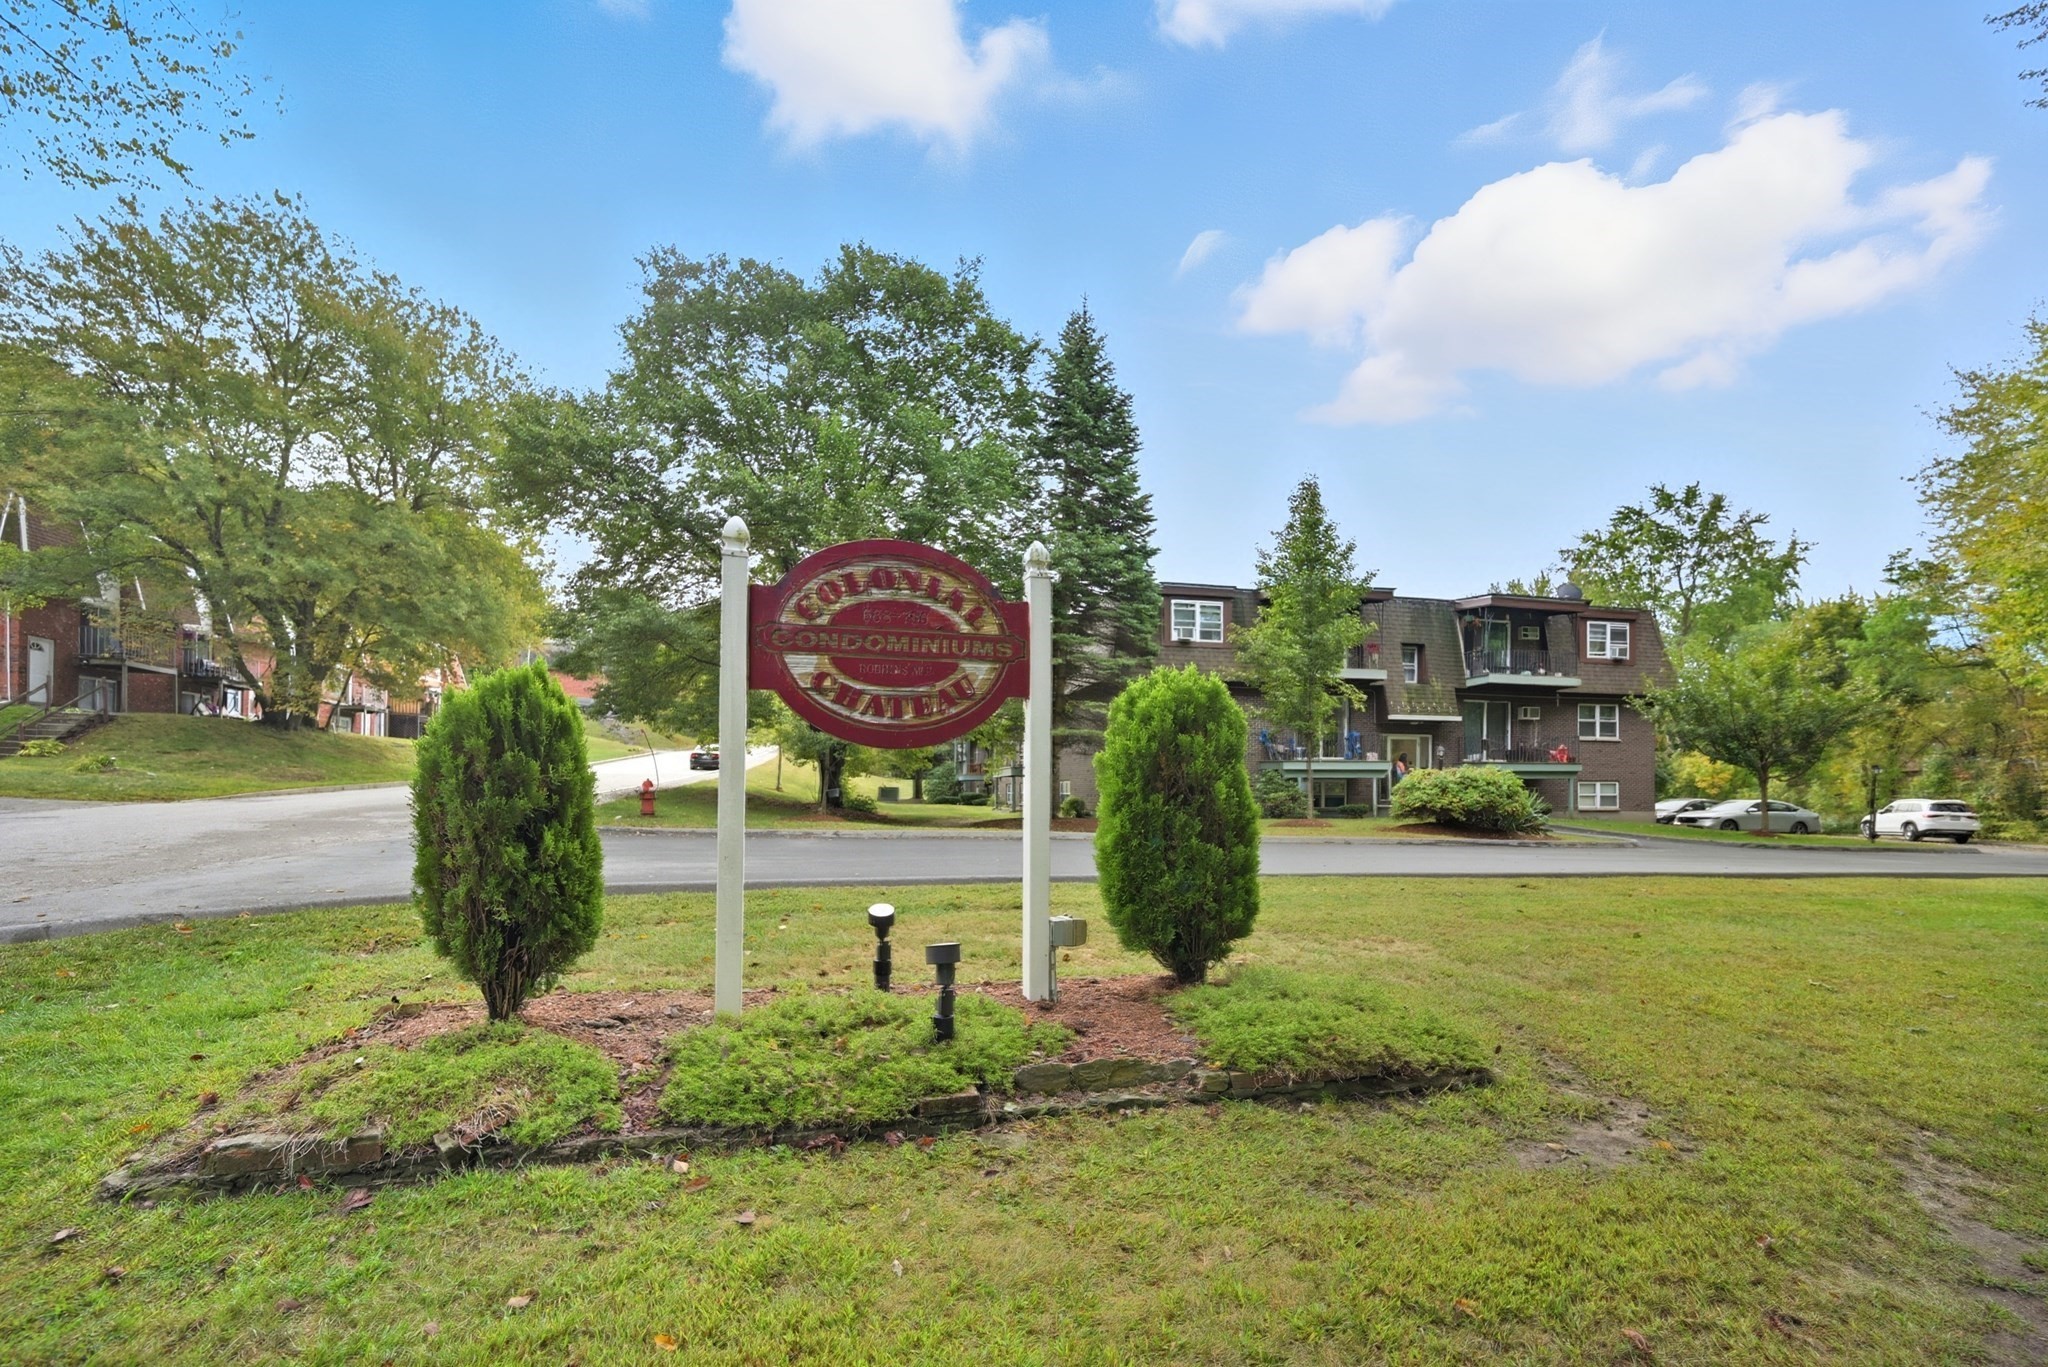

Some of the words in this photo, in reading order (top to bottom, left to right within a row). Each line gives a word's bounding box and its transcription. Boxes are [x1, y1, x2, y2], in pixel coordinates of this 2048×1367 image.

[796, 568, 986, 631] COLONIAL
[771, 629, 1013, 657] CONDOMINIUMS
[811, 671, 976, 718] CHATEAU
